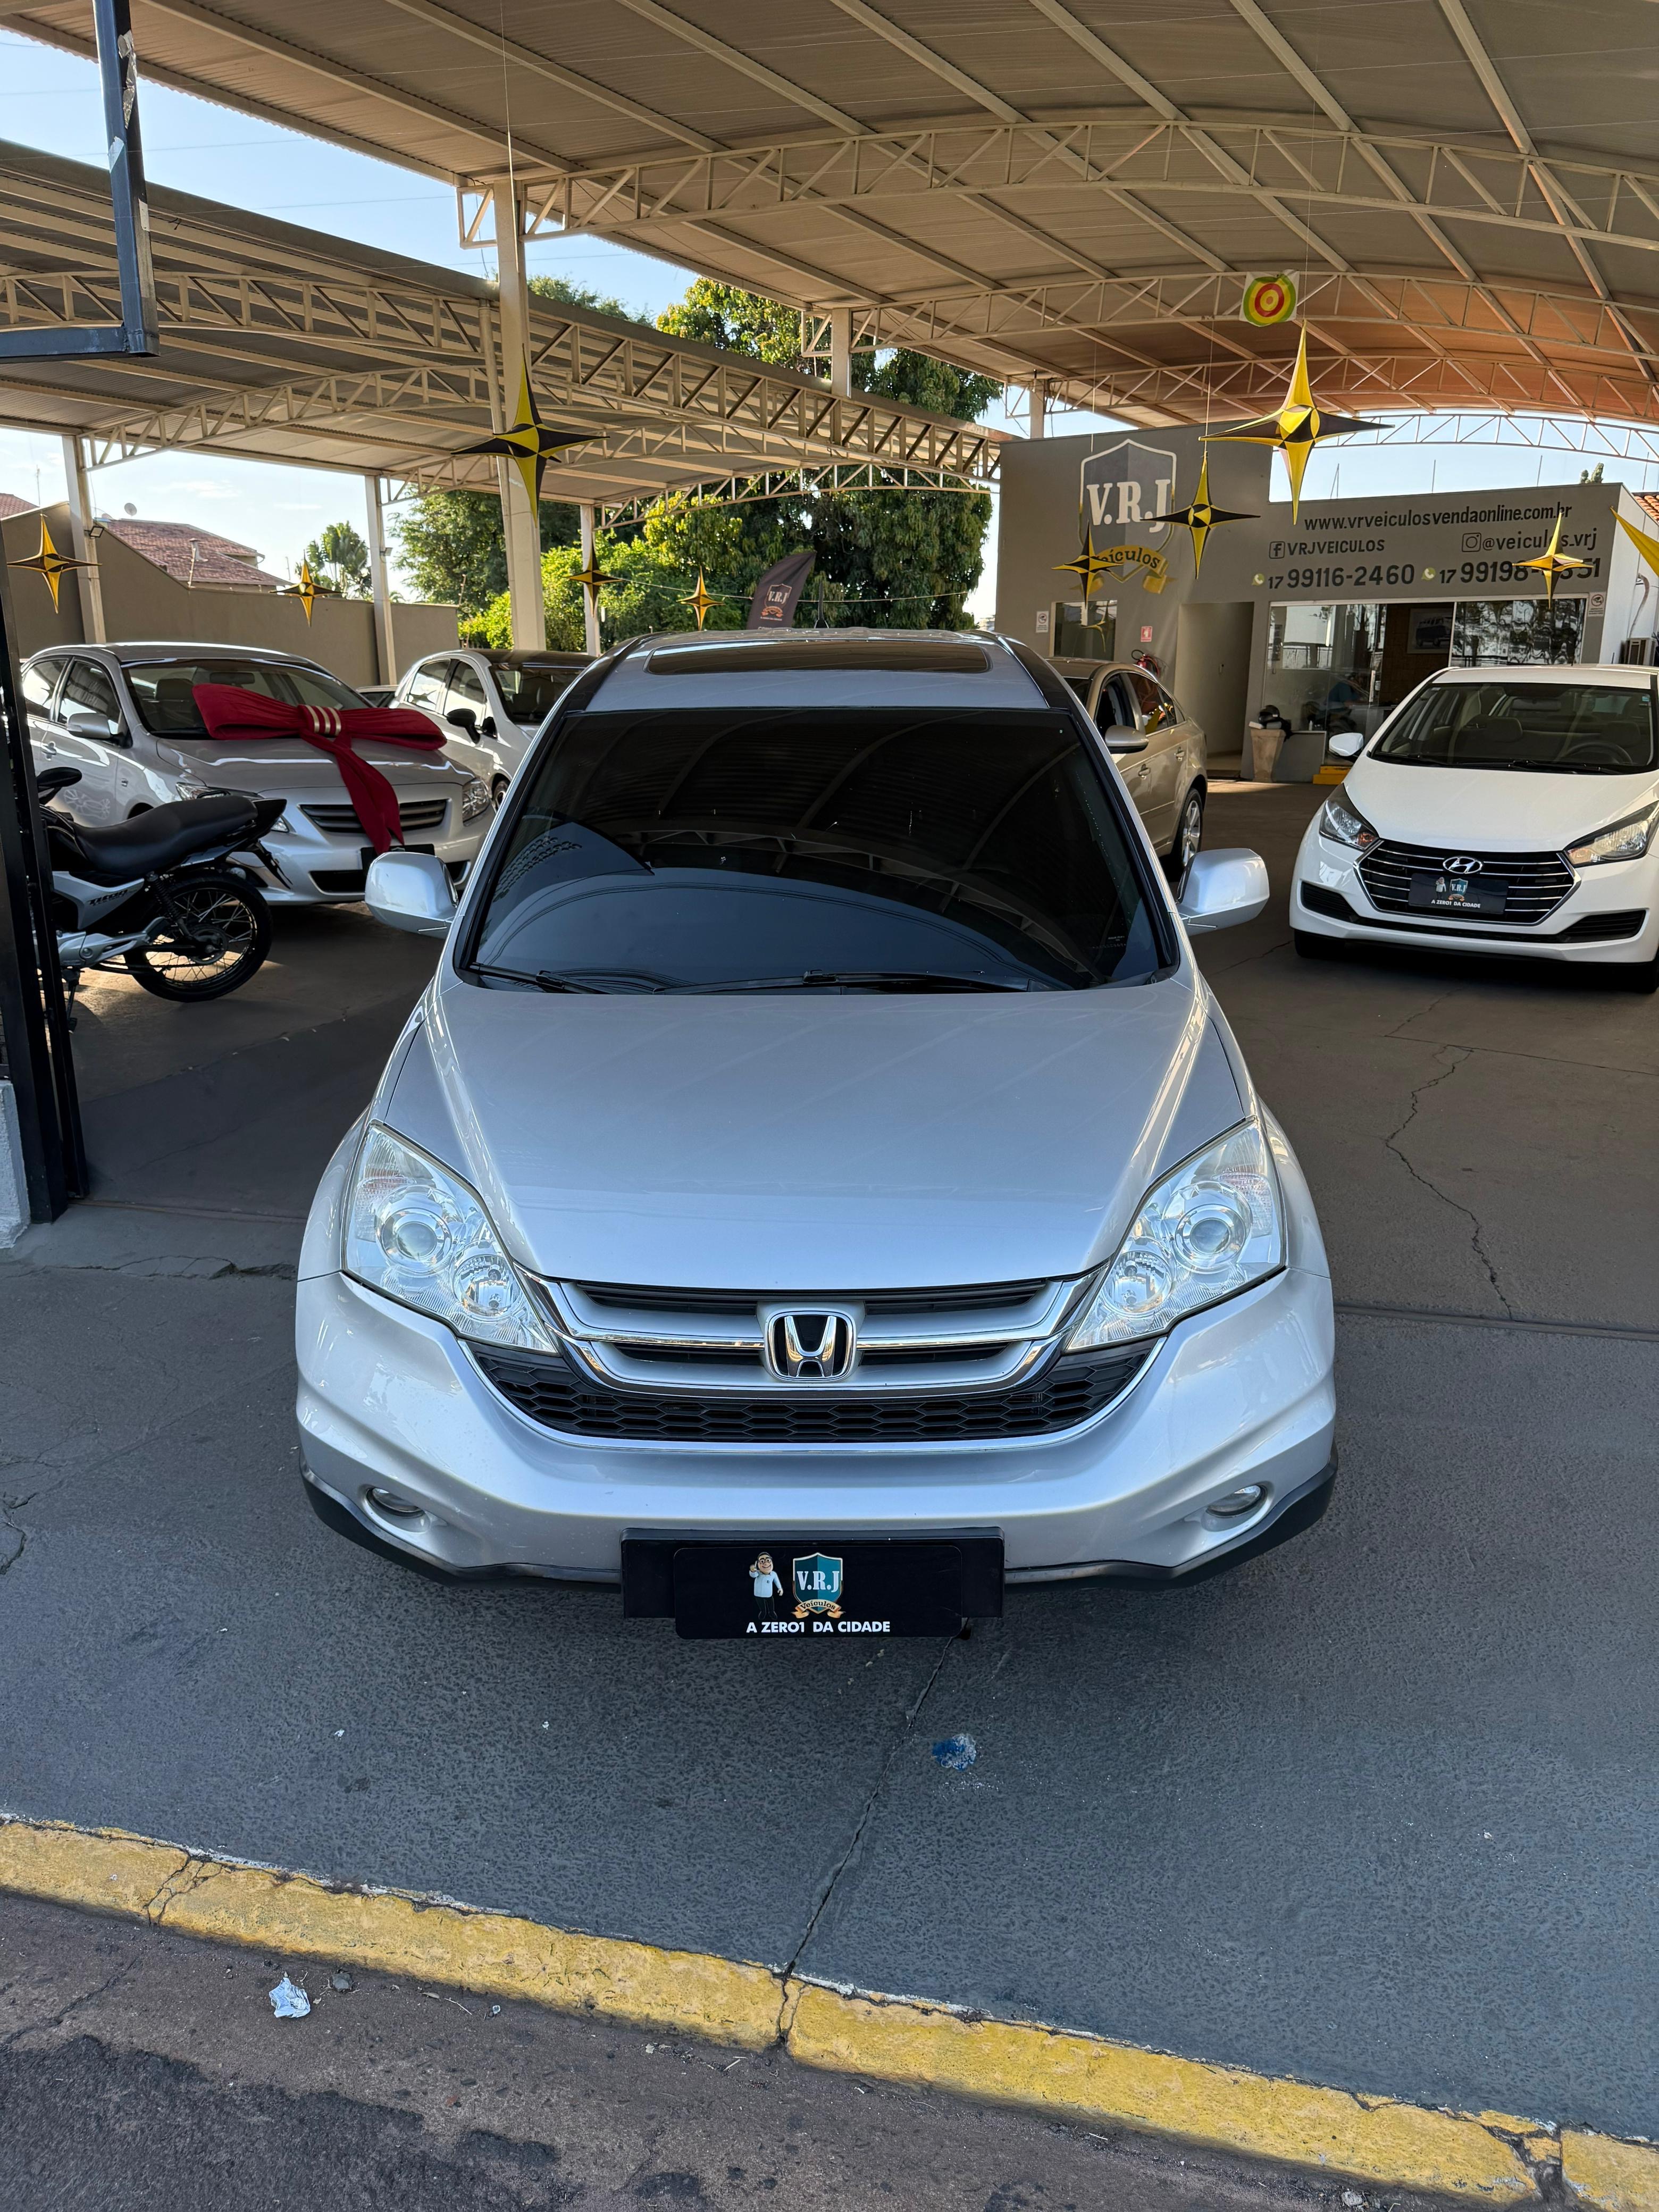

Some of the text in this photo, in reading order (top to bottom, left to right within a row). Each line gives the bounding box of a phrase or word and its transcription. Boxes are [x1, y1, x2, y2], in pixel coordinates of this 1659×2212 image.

[1086, 479, 1171, 533] V.R.J
[1304, 501, 1572, 531] www.vrveiculosvendaonline.com.br
[1287, 539, 1386, 556] VRJVEICULOS
[1482, 527, 1597, 551] @veiculs_vrj
[1268, 564, 1415, 589] 17 99116-2460
[1439, 558, 1601, 584] 17 99198-51
[797, 1570, 840, 1593] V.R.J
[799, 1600, 836, 1610] Veículos
[746, 1622, 758, 1633] A
[813, 1621, 834, 1632] DA
[837, 1621, 890, 1632] CIDADE
